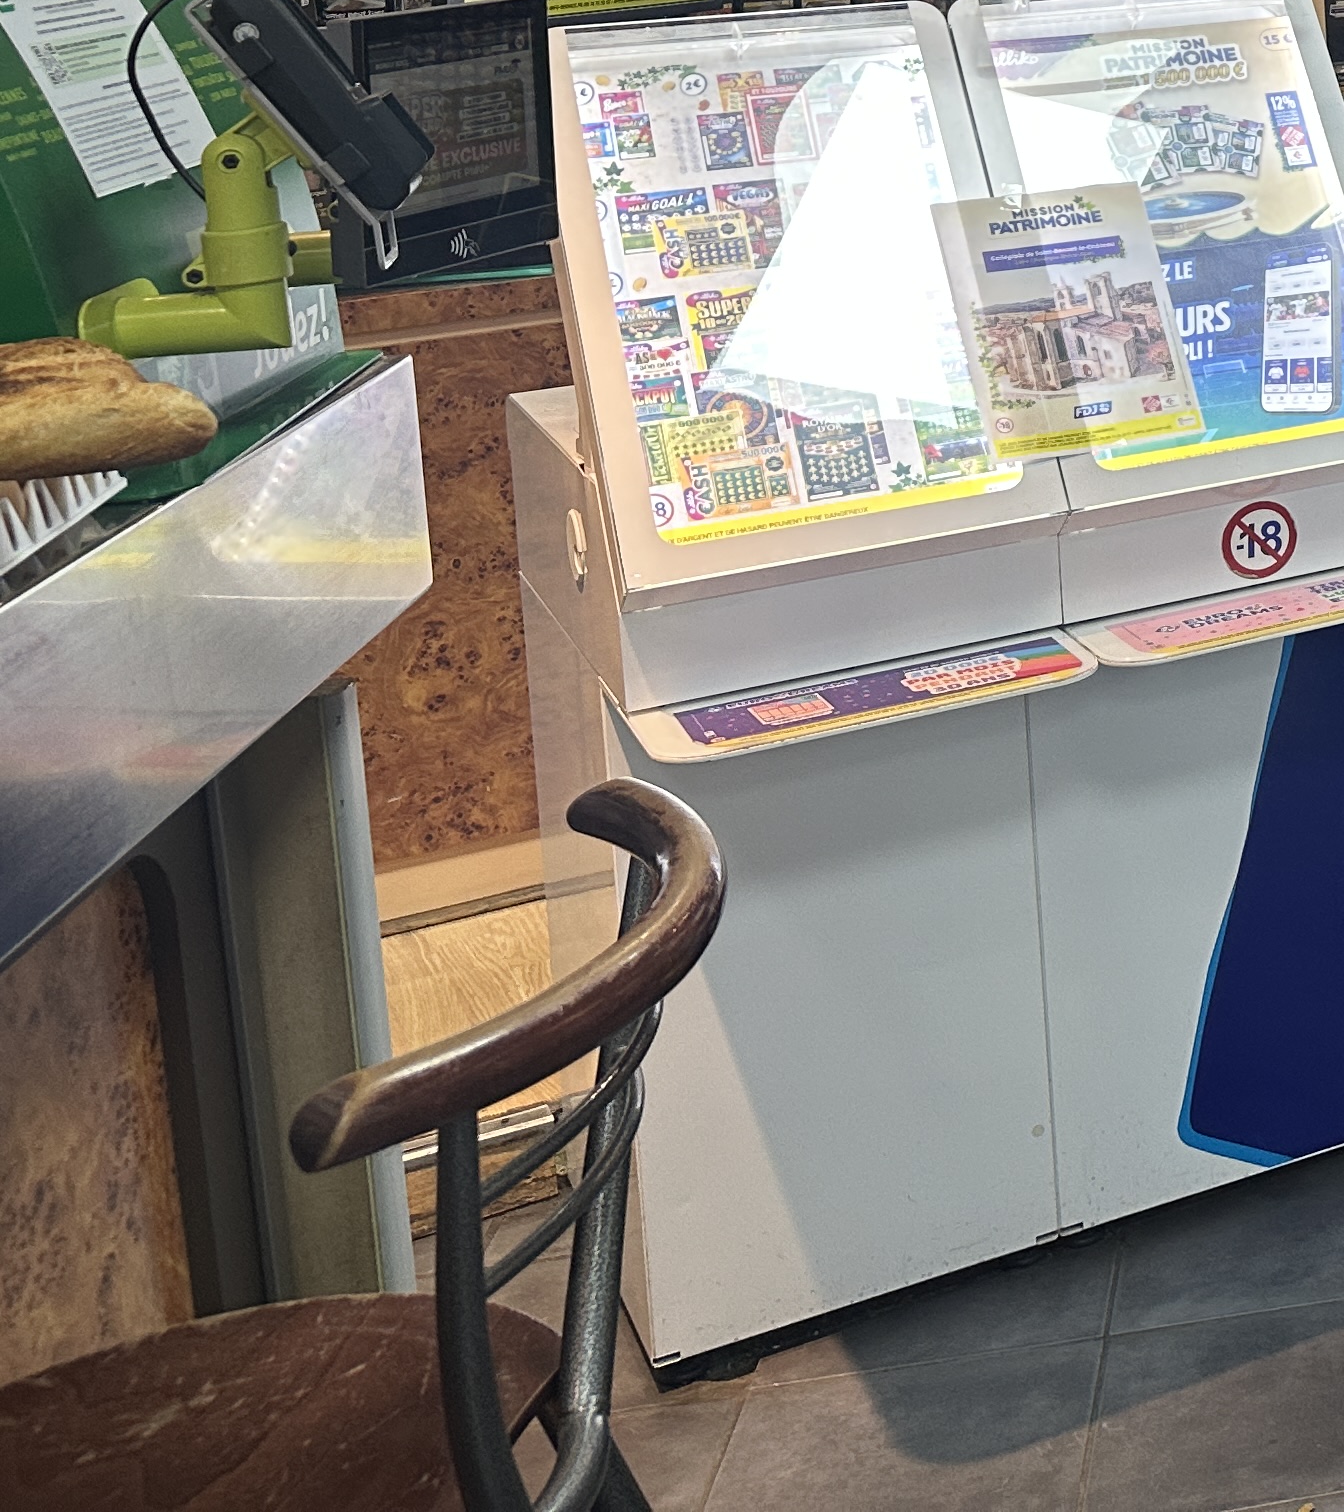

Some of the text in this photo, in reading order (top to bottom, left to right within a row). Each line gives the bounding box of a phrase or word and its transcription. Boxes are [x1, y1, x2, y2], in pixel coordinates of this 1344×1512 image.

[1263, 34, 1281, 46] 15
[1104, 46, 1238, 74] PATRIMOINE
[1269, 93, 1297, 112] 12%
[1011, 202, 1076, 221] MISSION
[988, 210, 1103, 236] PATRIMOINE
